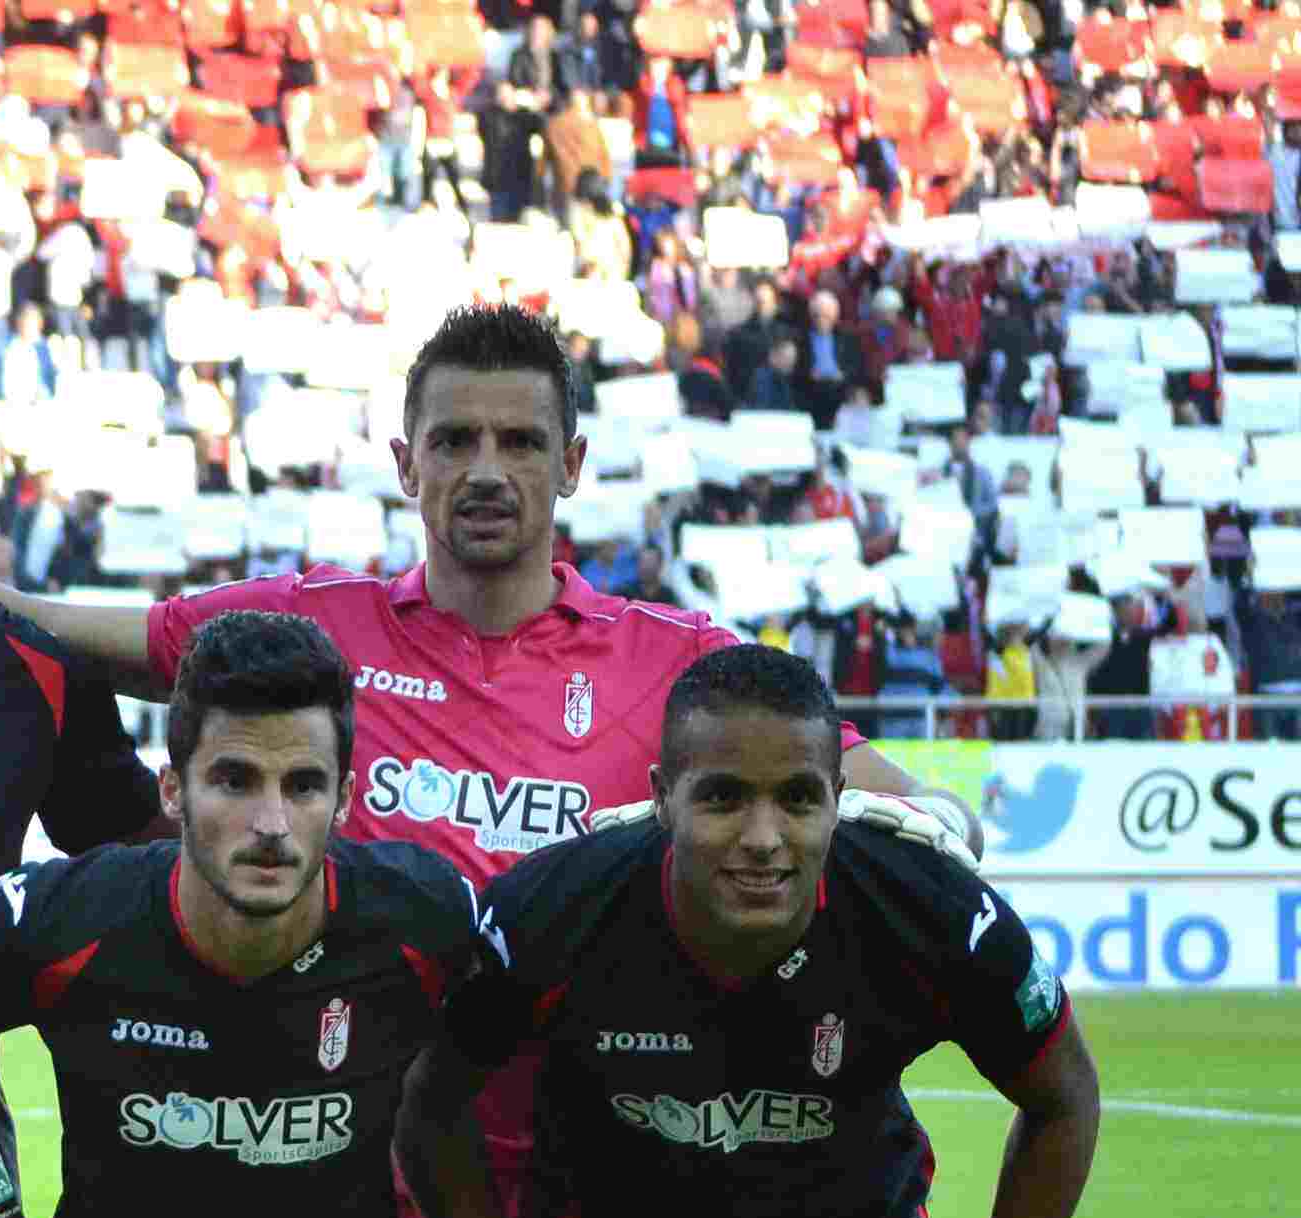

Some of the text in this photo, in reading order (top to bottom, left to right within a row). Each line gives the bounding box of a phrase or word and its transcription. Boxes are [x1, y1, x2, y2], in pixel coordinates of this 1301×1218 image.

[354, 665, 447, 702] Joma
[367, 761, 589, 836] SOLVER
[1029, 890, 1233, 985] odo
[111, 1017, 209, 1050] Joma
[597, 1031, 693, 1052] Joma
[123, 1094, 349, 1146] SOLVER
[612, 1091, 831, 1146] SOLVER
